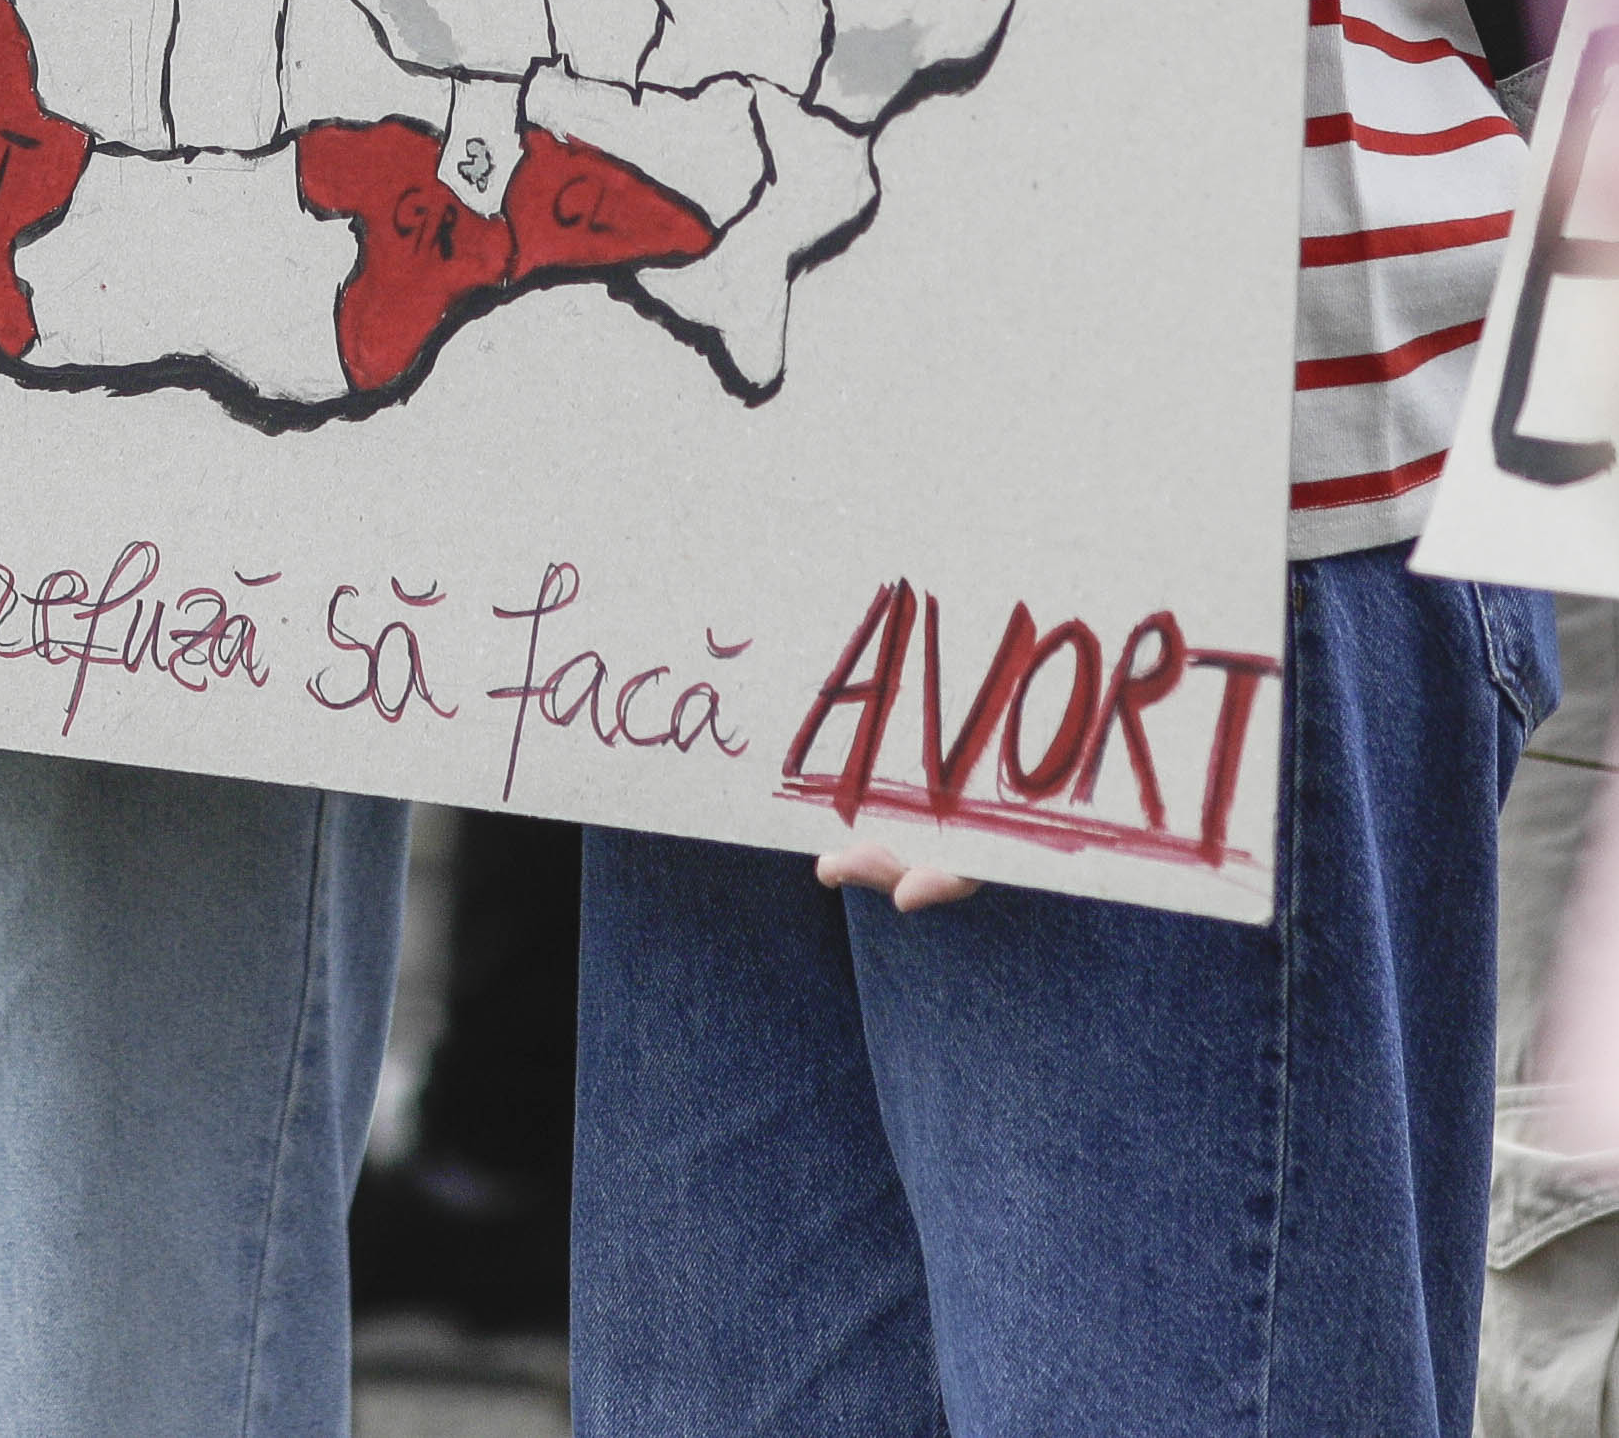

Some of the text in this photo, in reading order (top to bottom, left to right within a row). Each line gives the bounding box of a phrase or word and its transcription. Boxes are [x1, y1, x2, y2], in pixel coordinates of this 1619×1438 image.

[392, 186, 459, 261] GR
[552, 174, 612, 234] CL
[486, 561, 753, 802] facă
[778, 577, 1284, 869] AVORT
